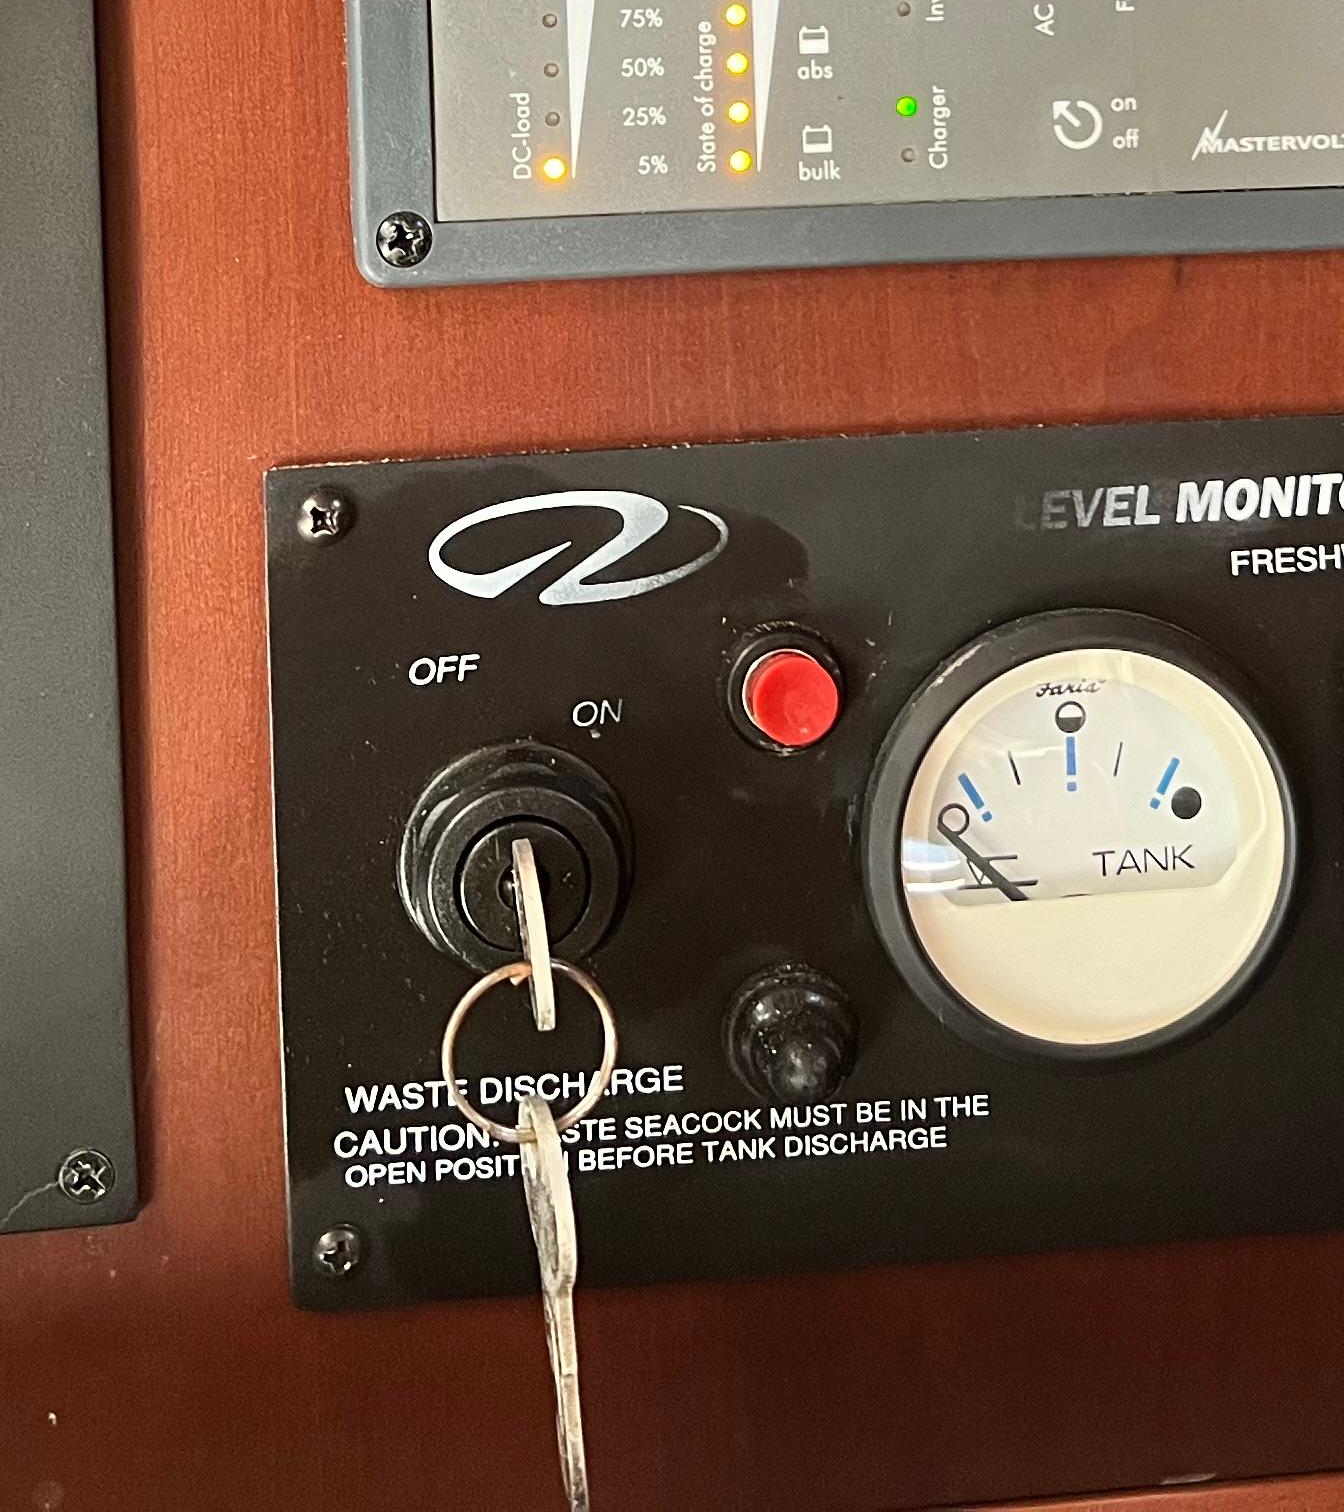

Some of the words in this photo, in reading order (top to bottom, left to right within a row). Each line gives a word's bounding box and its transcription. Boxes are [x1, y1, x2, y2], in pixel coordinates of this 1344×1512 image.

[620, 9, 663, 28] 75%
[1034, 4, 1055, 36] AC
[621, 58, 665, 77] 50%
[693, 20, 717, 90] charge
[797, 59, 833, 80] abs
[622, 107, 667, 126] 25%
[695, 96, 714, 118] of
[1111, 97, 1137, 112] on
[509, 92, 531, 180] DC-load
[928, 85, 951, 169] Charger
[1113, 128, 1139, 149] off
[697, 123, 716, 173] State
[638, 155, 668, 175] 5%
[798, 161, 841, 181] bulk
[1016, 484, 1161, 530] EVEL
[408, 653, 480, 686] OFF
[573, 699, 623, 727] ON
[1092, 844, 1195, 876] TANK
[624, 1108, 761, 1141] SEACOCK
[770, 1103, 849, 1129] MUST
[857, 1100, 891, 1123] BE
[900, 1098, 928, 1120] IN
[935, 1094, 988, 1118] THE
[345, 1161, 426, 1187] OPEN
[435, 1151, 568, 1181] POSIT
[579, 1143, 693, 1171] BEFORE
[702, 1137, 776, 1163] TANK
[785, 1126, 947, 1157] DISCHARGE
